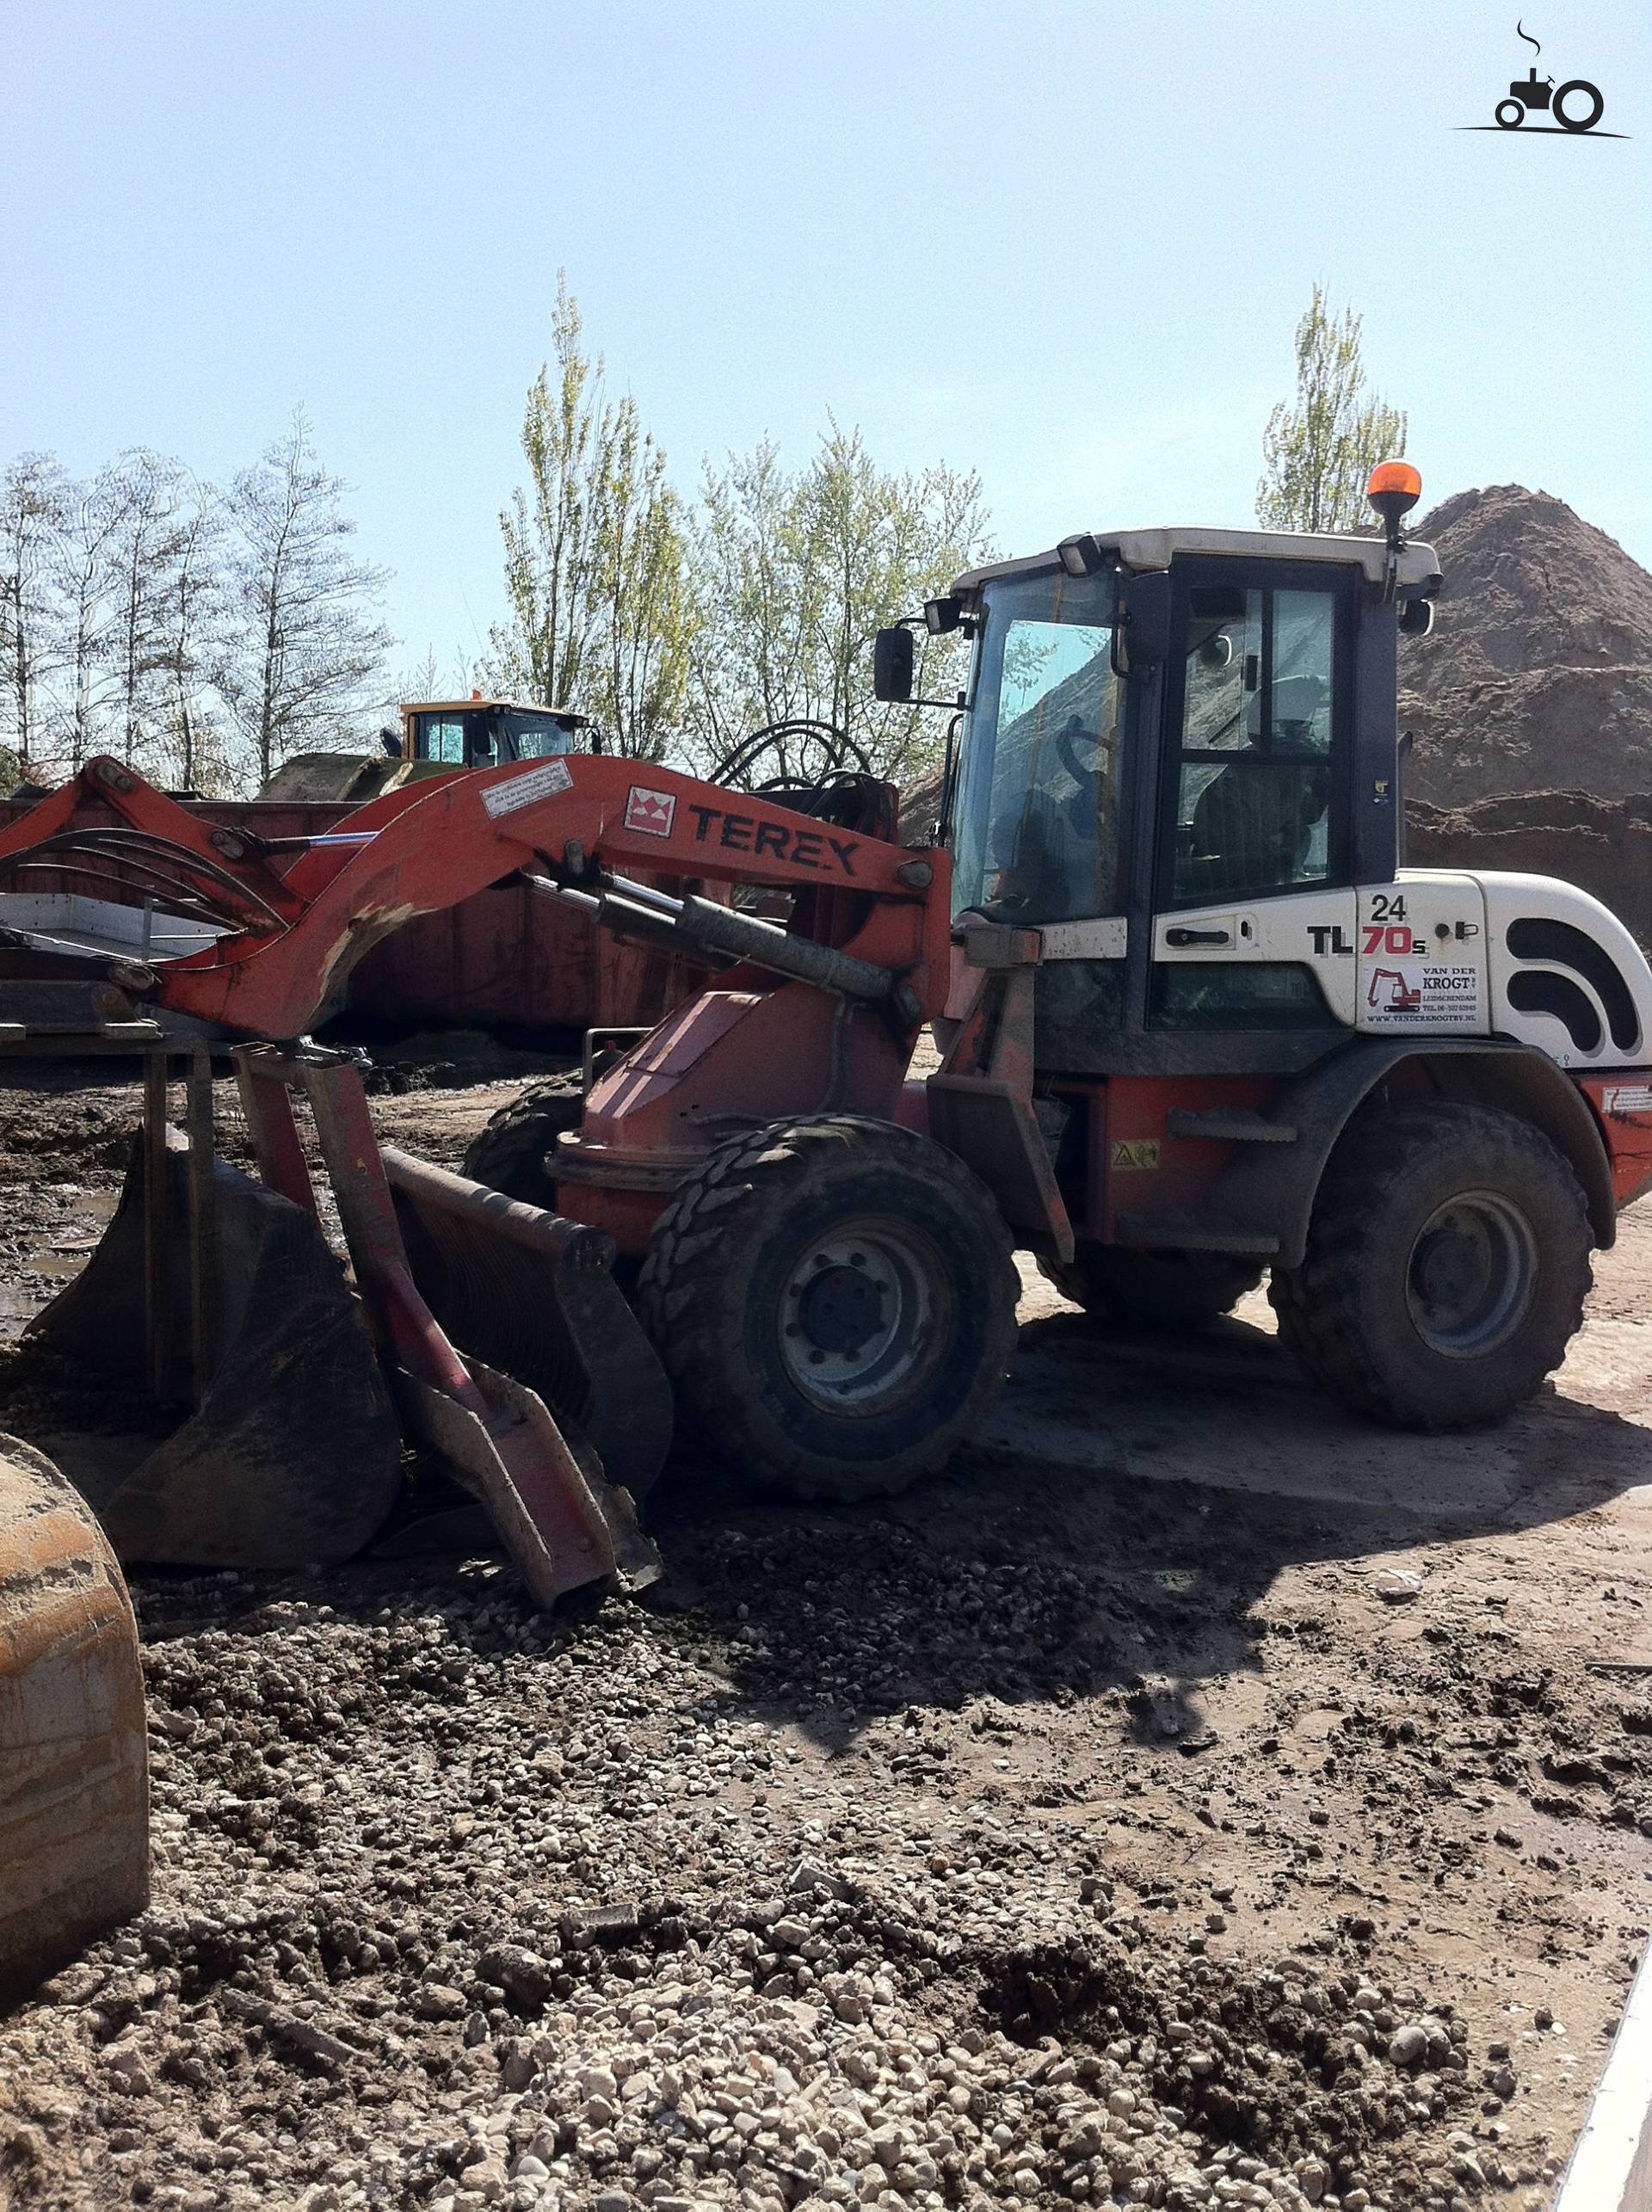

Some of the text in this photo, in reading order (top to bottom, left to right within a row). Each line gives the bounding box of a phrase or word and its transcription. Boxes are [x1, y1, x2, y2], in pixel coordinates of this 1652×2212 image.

[689, 804, 860, 877] TEREX
[1371, 894, 1407, 921] 24
[1422, 977, 1470, 989] KROGT
